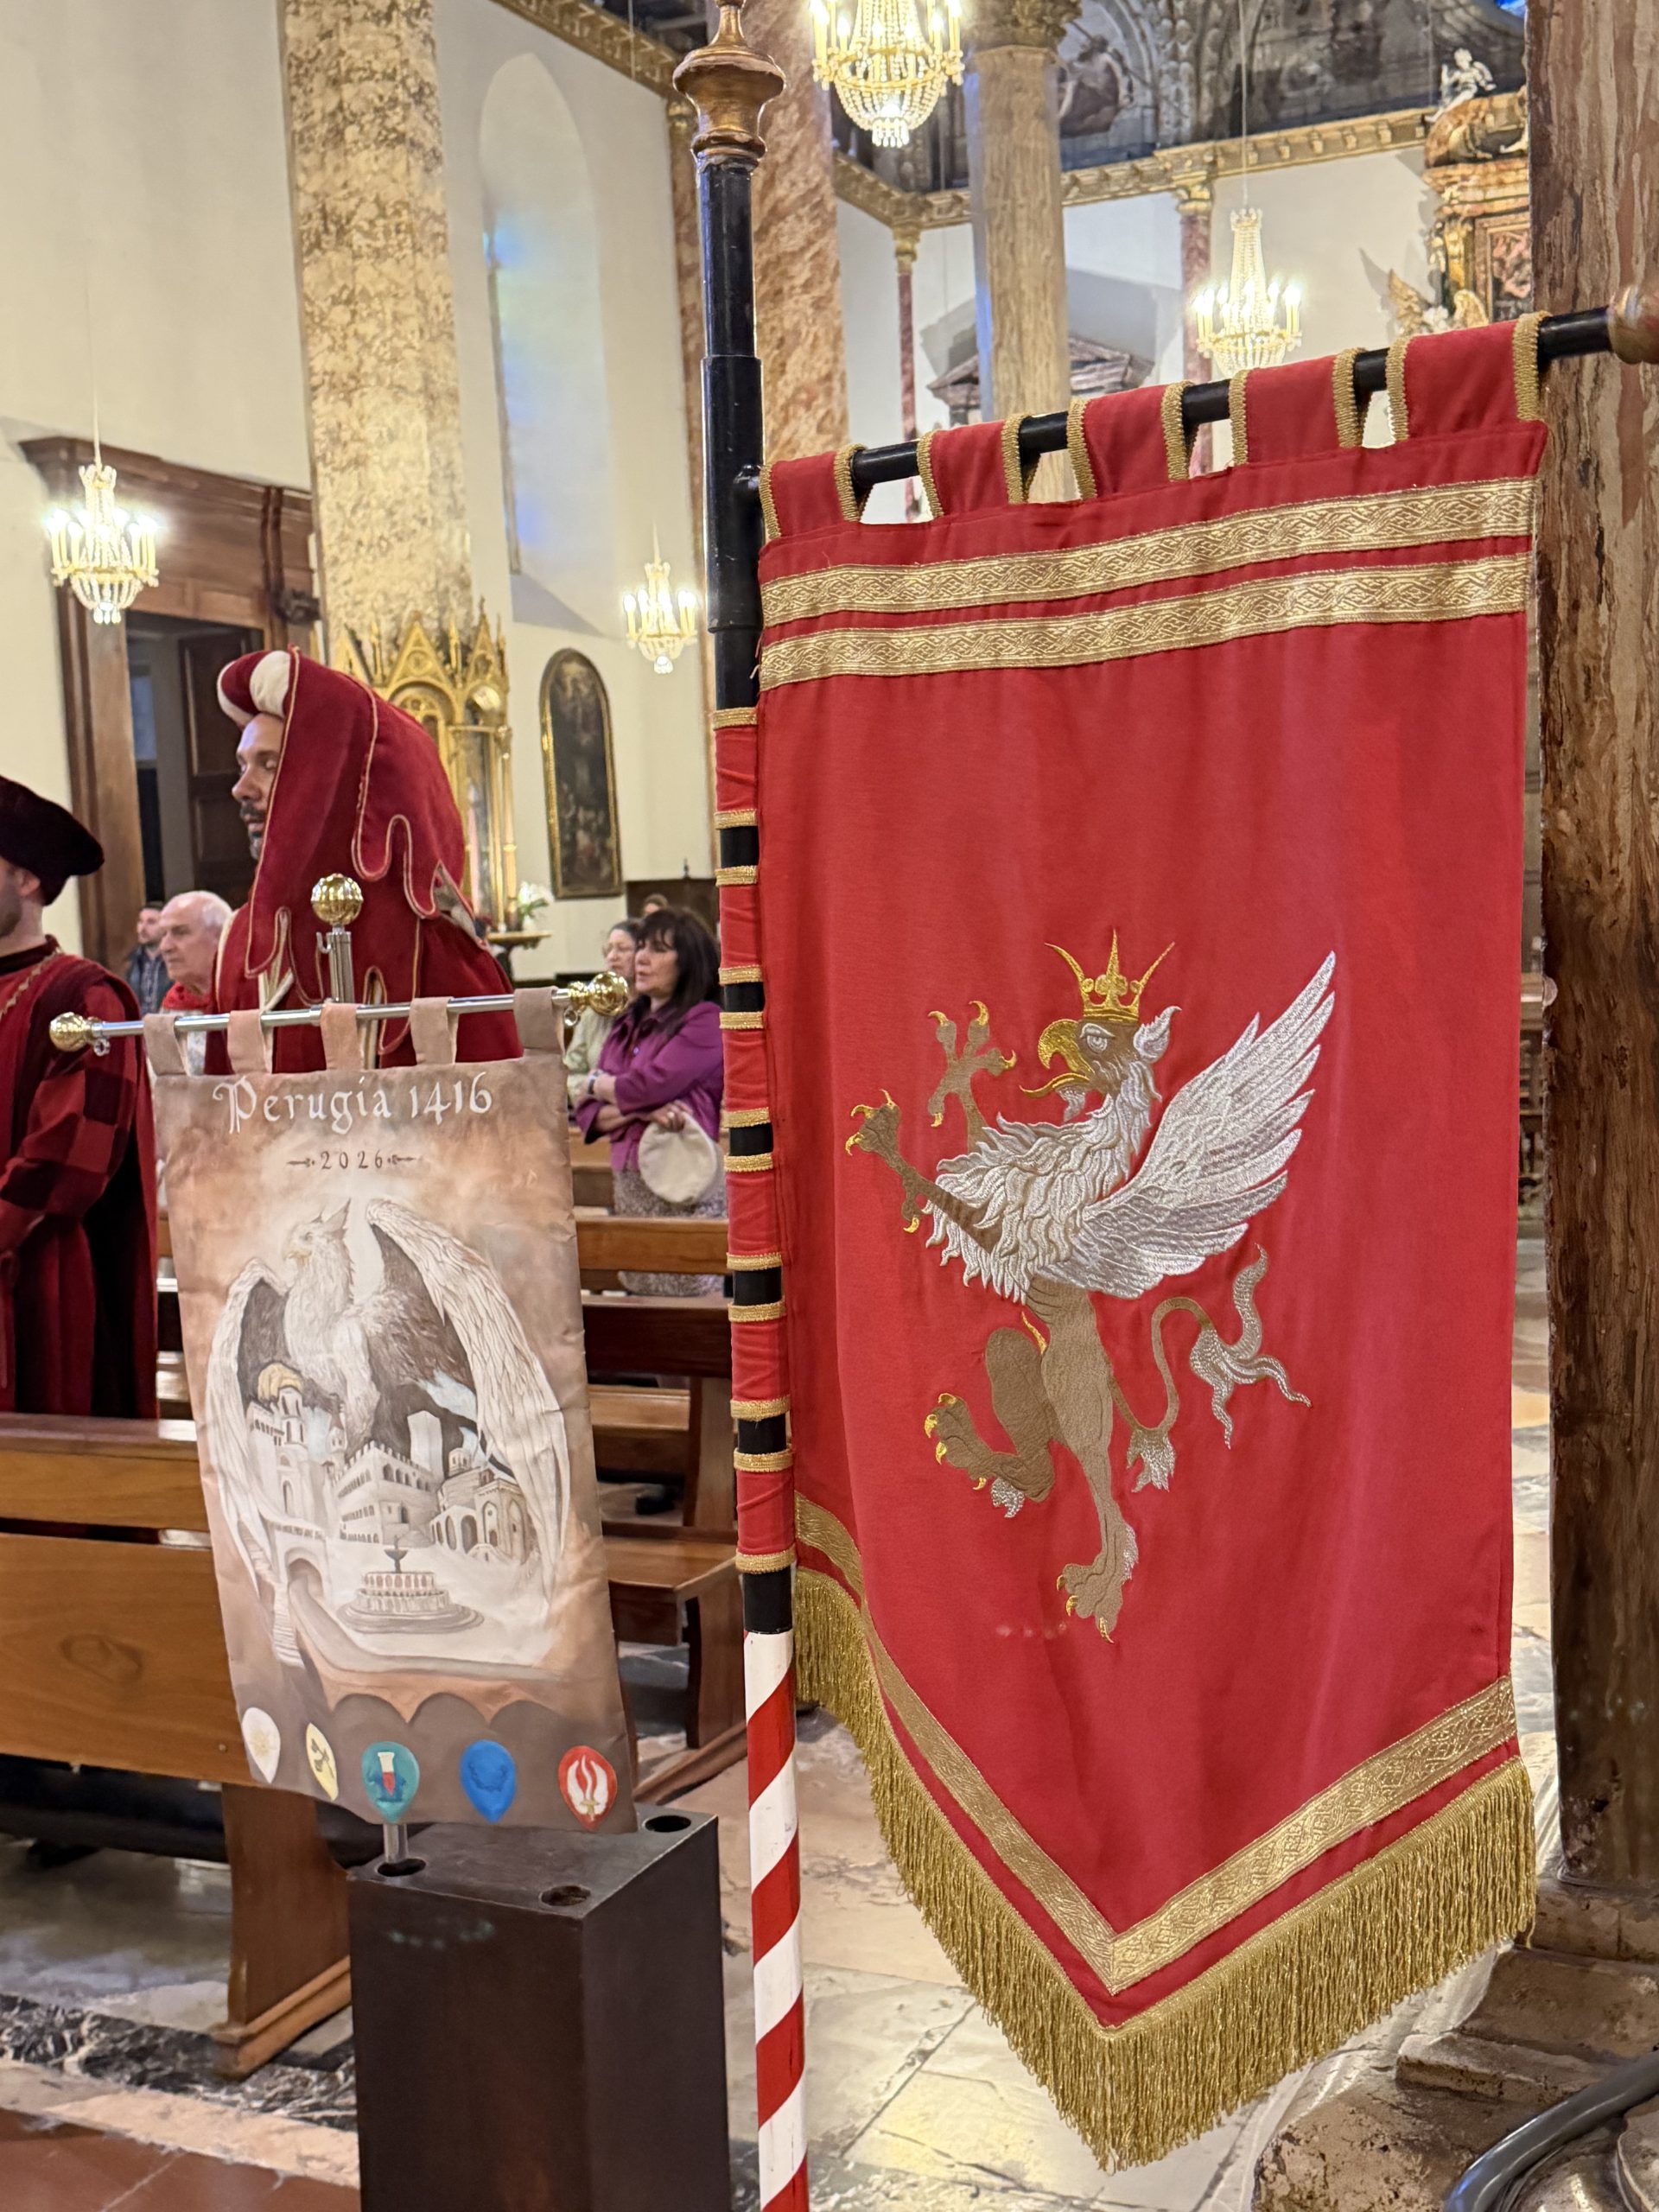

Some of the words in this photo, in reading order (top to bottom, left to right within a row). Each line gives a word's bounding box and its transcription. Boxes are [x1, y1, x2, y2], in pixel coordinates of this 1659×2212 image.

[213, 1075, 391, 1135] Perugia
[410, 1071, 493, 1125] 1416
[320, 1150, 384, 1170] 2026
